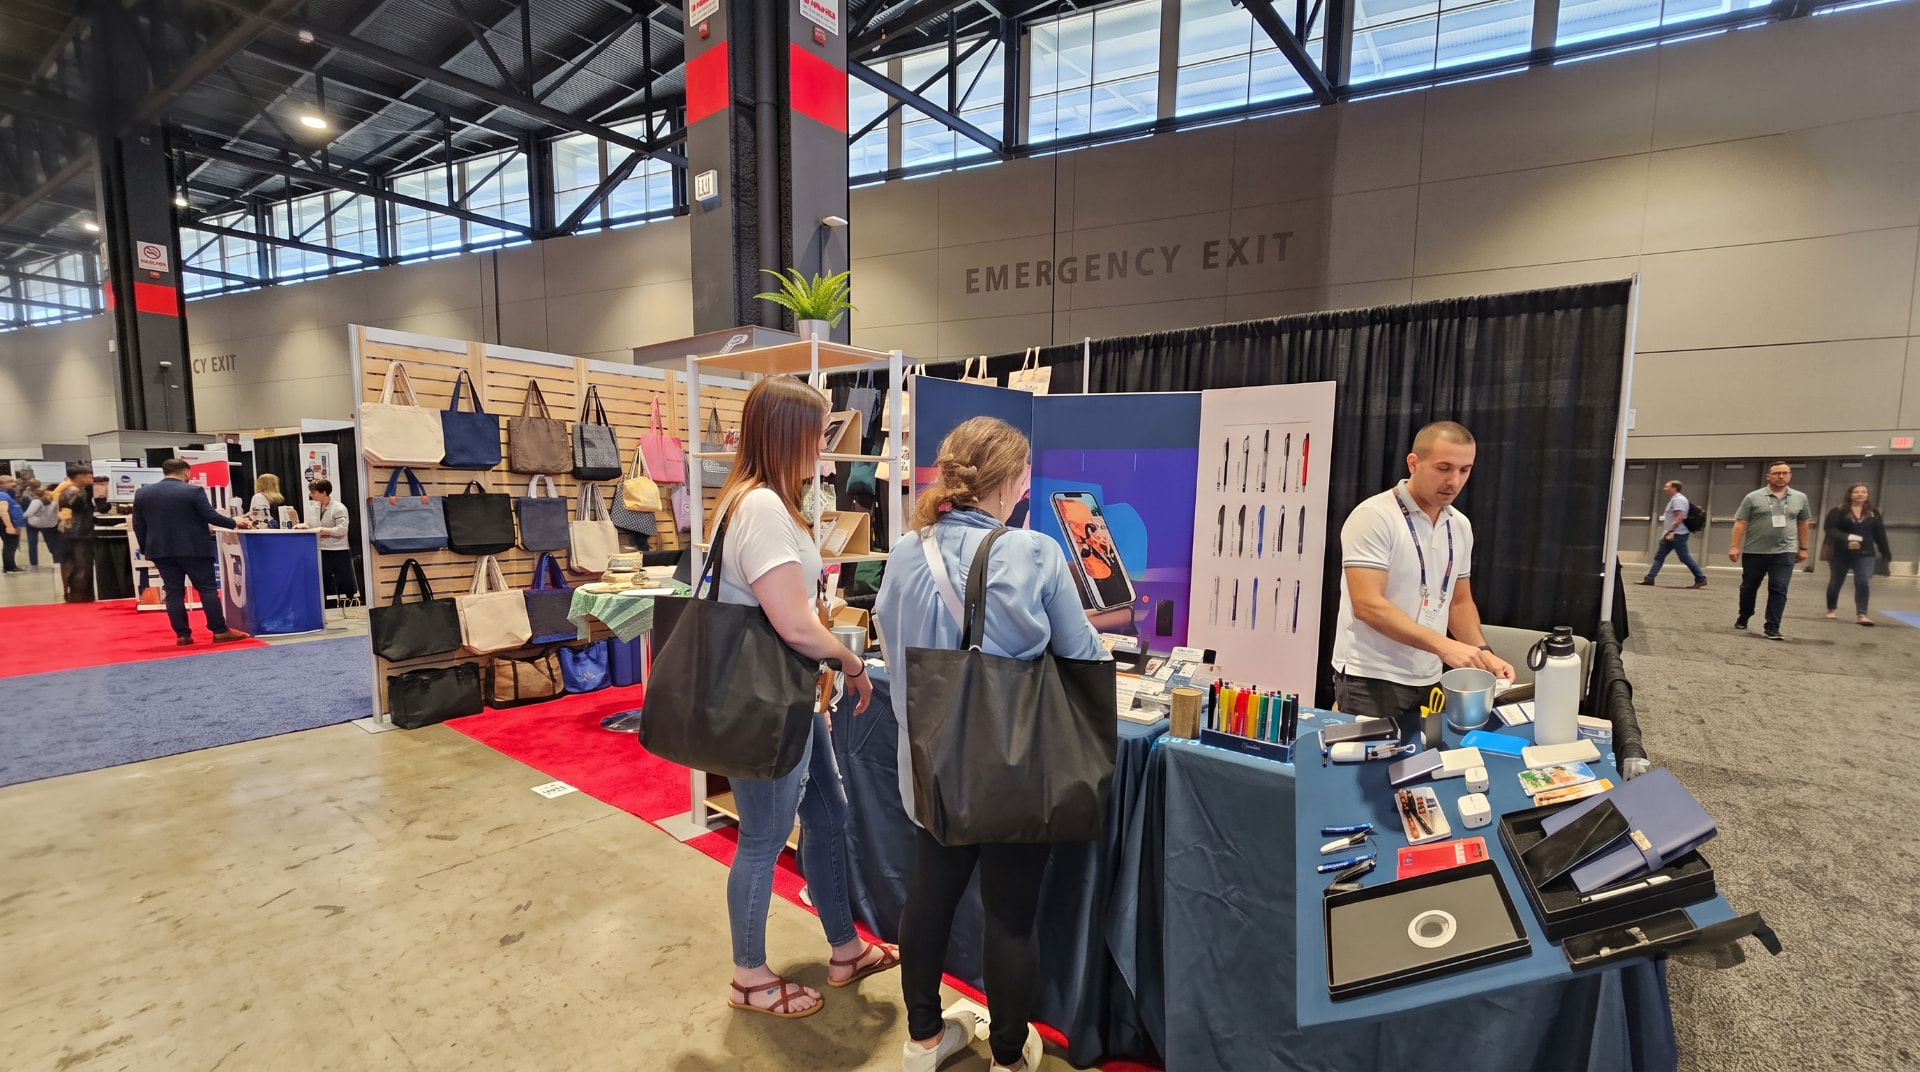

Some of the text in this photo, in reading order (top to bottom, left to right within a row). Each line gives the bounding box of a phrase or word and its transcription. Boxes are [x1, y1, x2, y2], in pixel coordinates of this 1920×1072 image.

[966, 231, 1294, 294] EMERGENCY EXIT
[211, 354, 236, 372] EXIT
